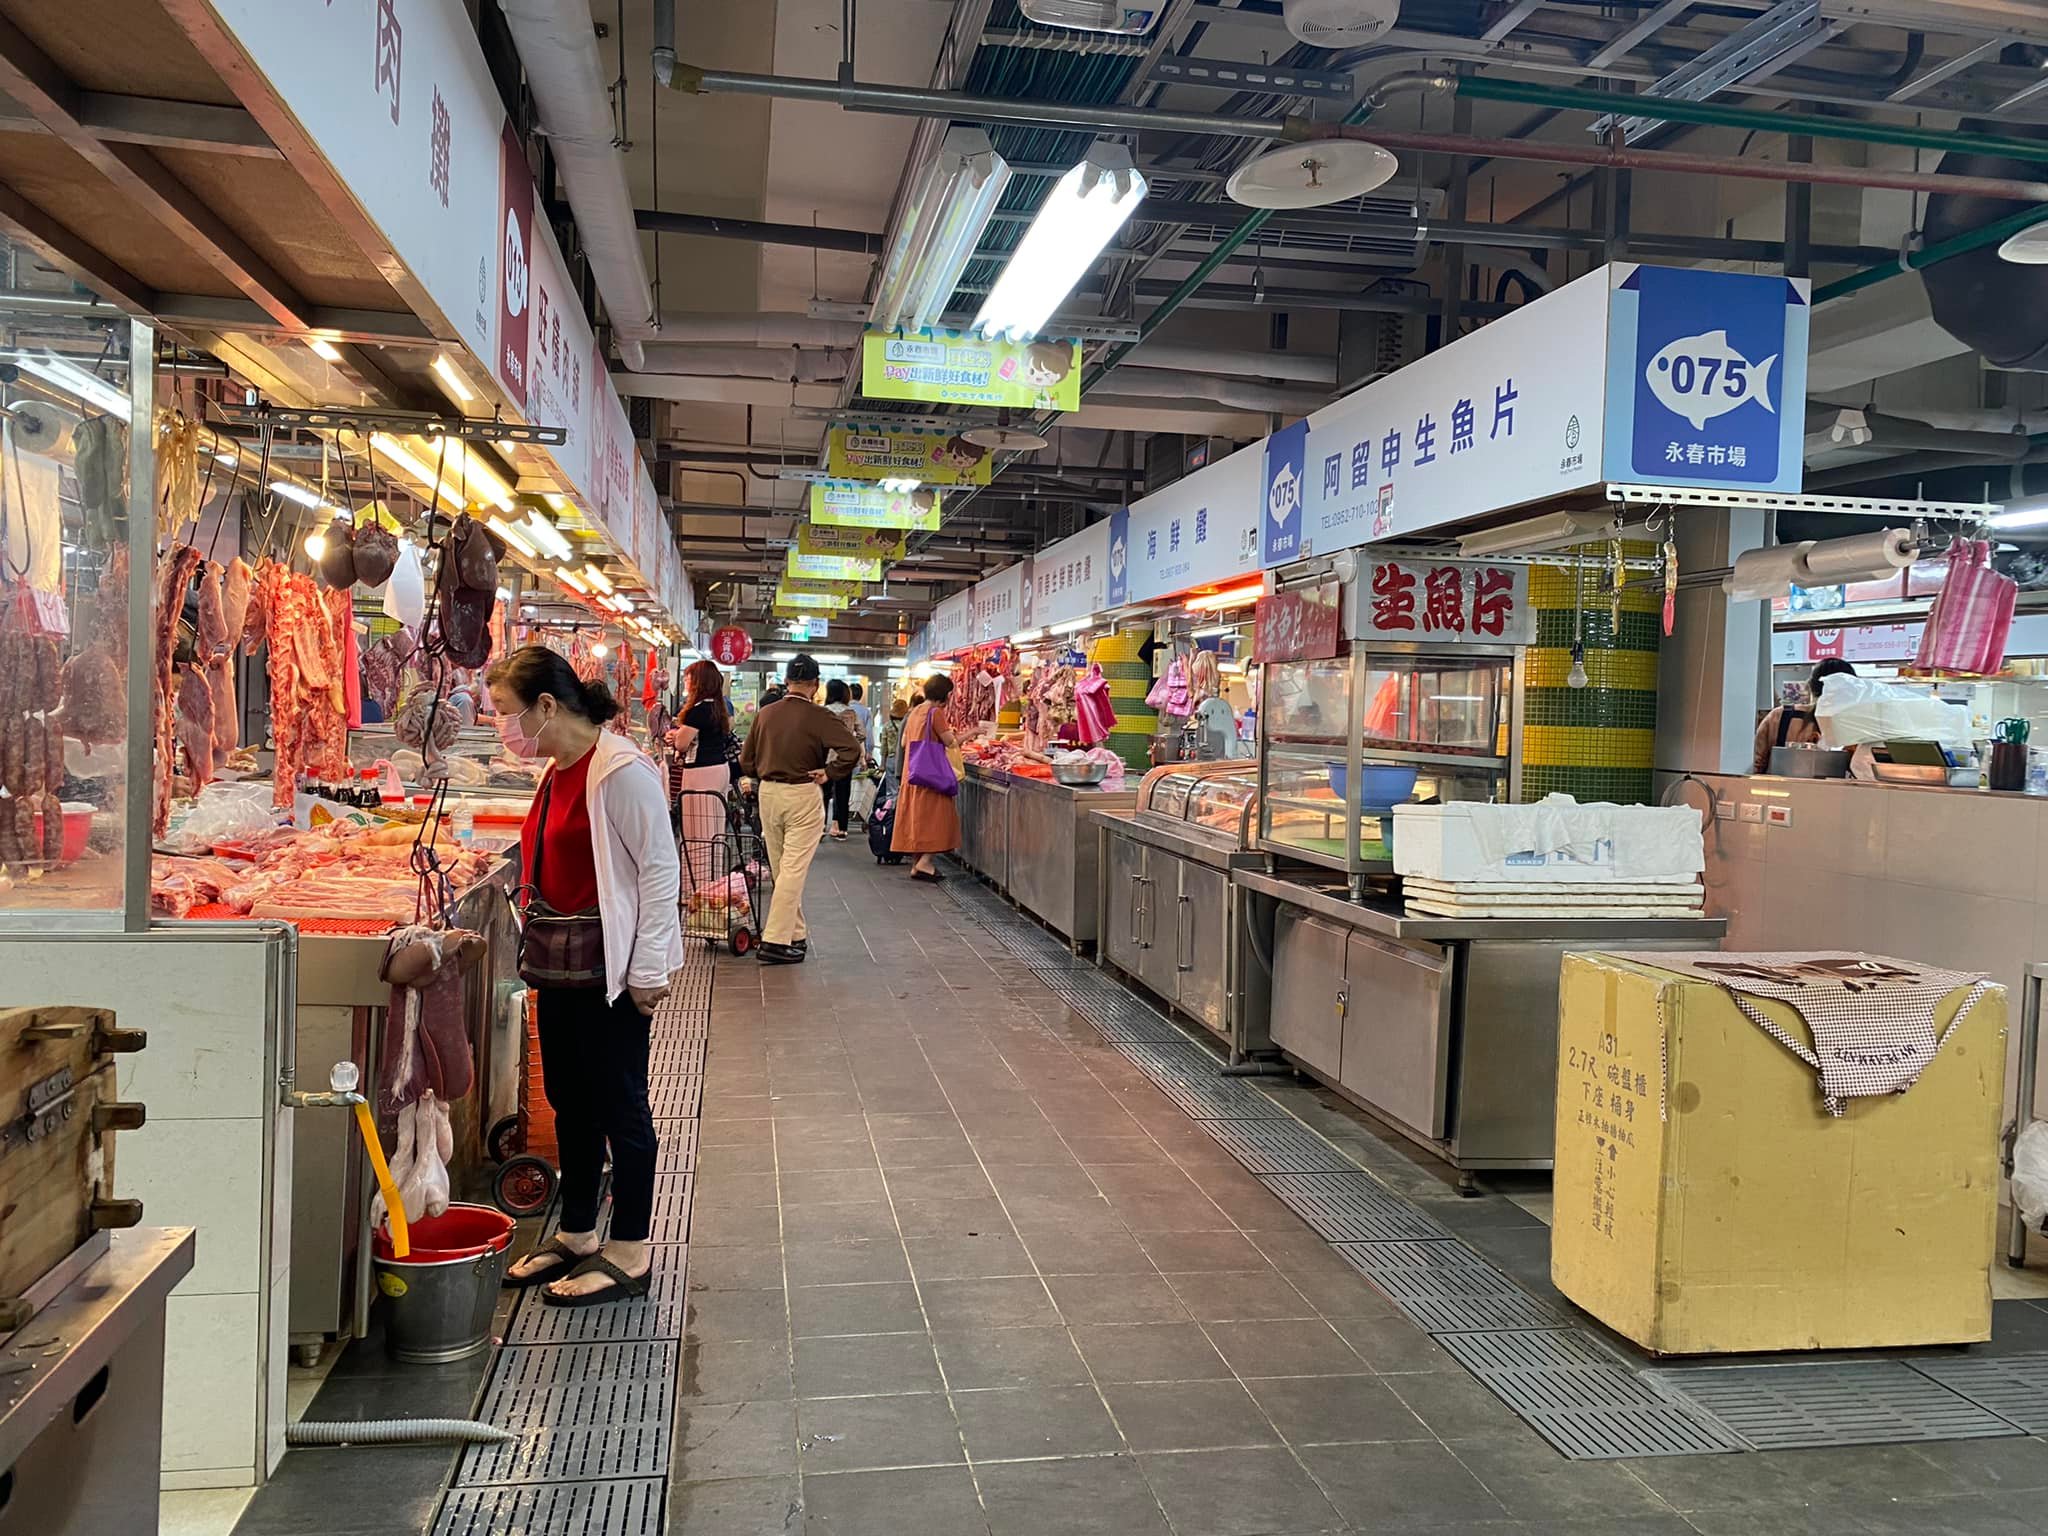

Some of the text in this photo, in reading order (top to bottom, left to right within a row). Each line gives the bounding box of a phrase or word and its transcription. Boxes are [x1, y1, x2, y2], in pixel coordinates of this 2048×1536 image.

[508, 234, 523, 300] 013
[1671, 355, 1747, 398] 075
[1323, 378, 1519, 501] 阿留申生魚片
[1665, 441, 1747, 467] 永春市場
[1275, 479, 1295, 509] 075
[1371, 562, 1514, 637] 生魚片
[1568, 1046, 1598, 1079] 2.7尺
[1582, 1081, 1604, 1108] 下座
